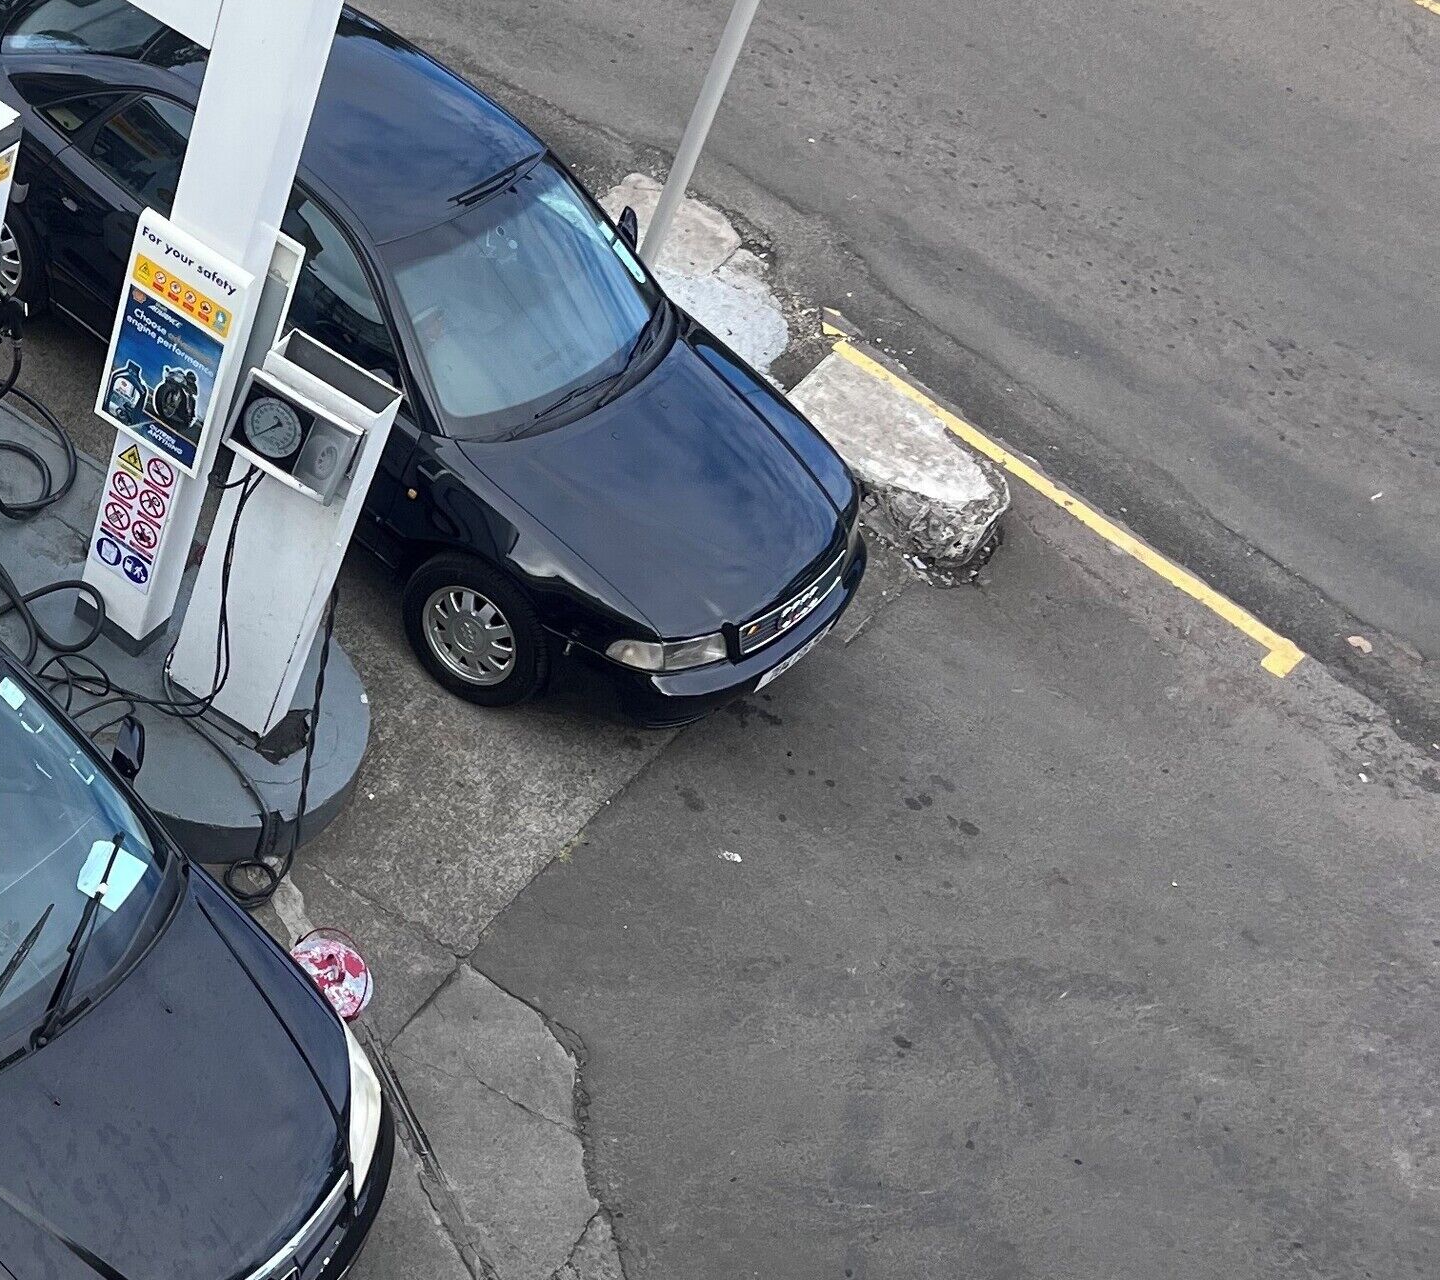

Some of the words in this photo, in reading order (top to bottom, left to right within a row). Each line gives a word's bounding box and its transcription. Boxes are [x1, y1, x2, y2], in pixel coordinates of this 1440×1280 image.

[142, 226, 162, 245] For
[165, 243, 194, 266] your
[197, 265, 237, 296] safety
[126, 315, 157, 339] engine
[134, 308, 167, 336] Choose
